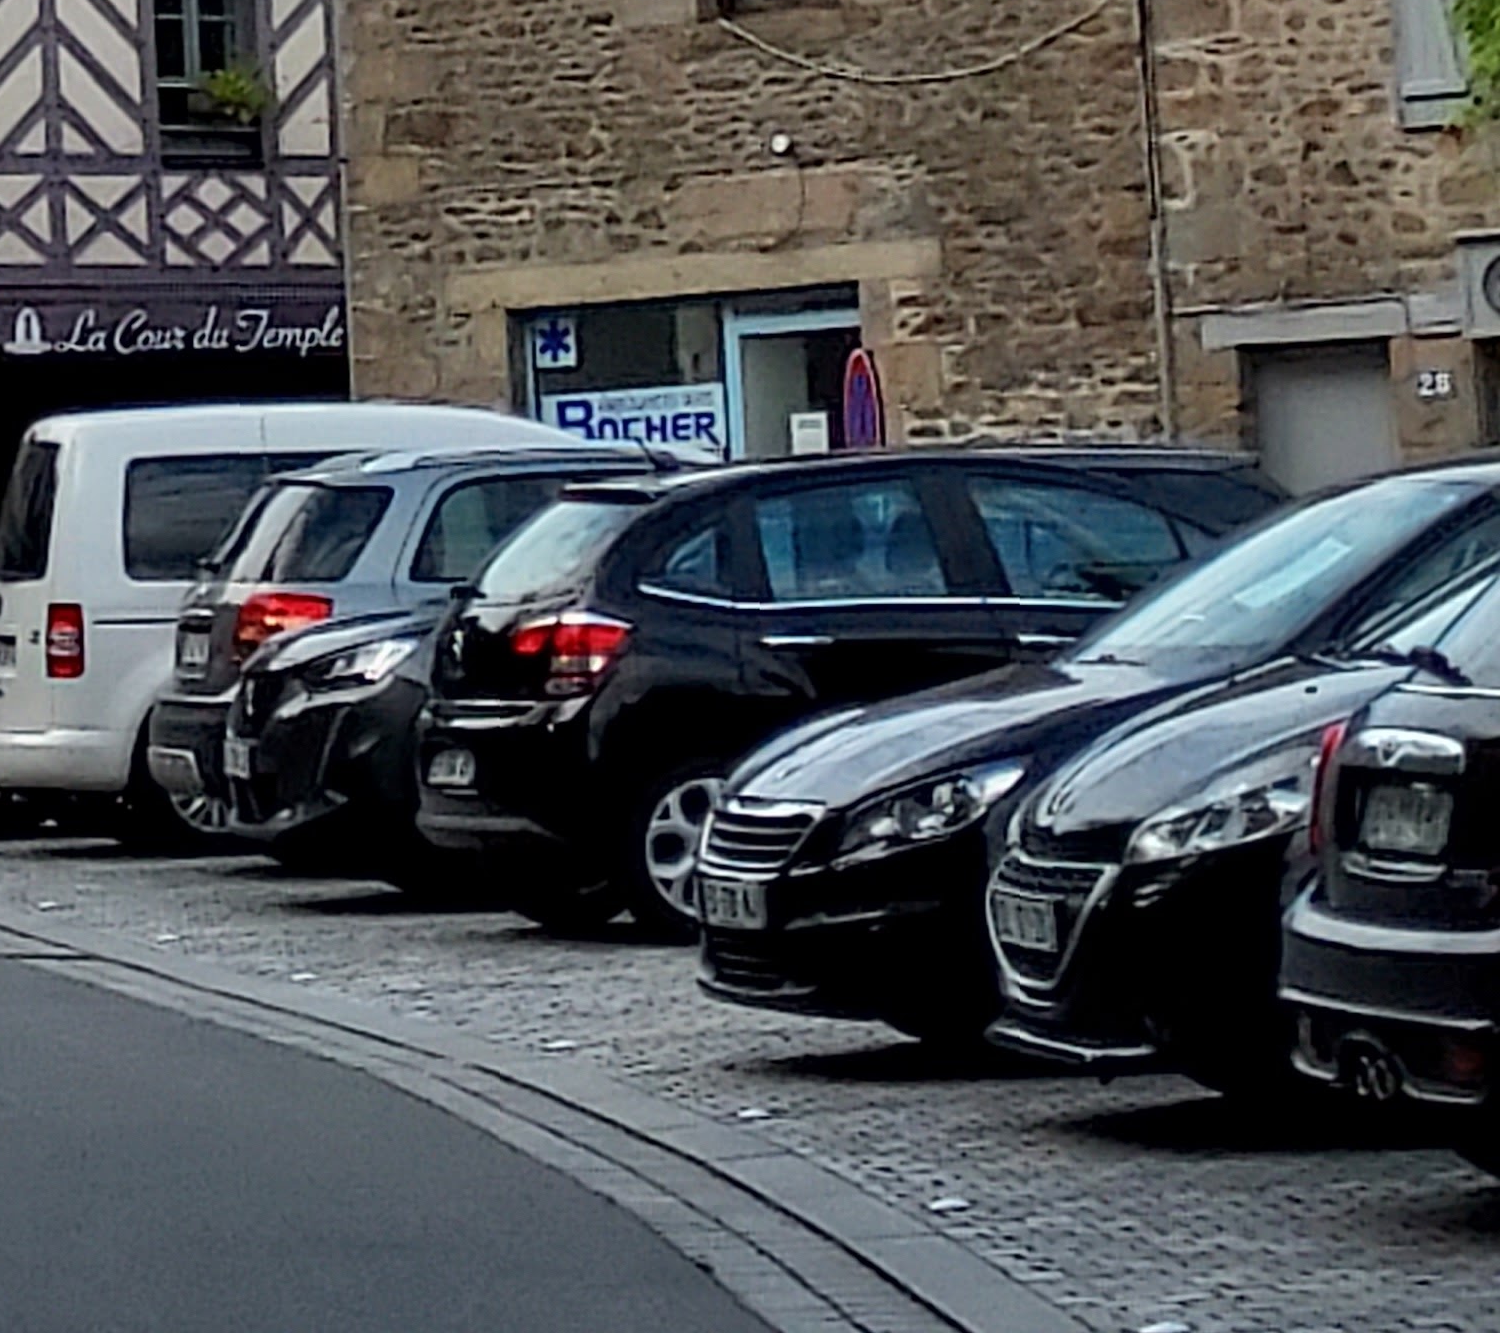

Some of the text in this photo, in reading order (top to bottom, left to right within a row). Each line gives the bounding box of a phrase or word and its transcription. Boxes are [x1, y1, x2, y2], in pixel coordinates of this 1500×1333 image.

[52, 305, 345, 358] La Cour du Temple
